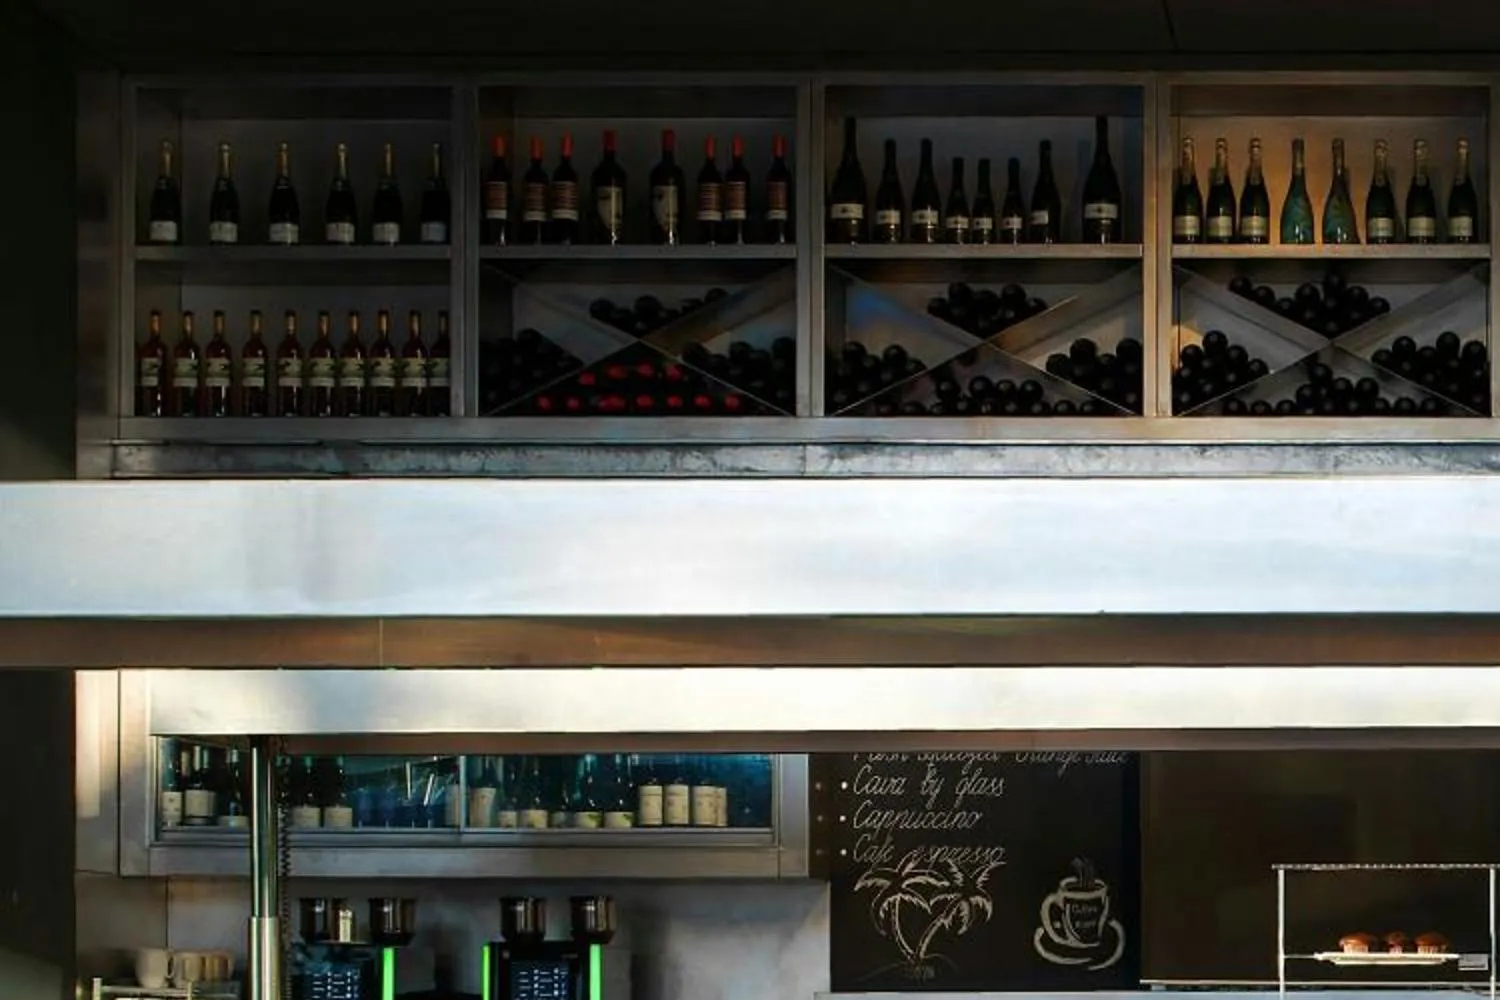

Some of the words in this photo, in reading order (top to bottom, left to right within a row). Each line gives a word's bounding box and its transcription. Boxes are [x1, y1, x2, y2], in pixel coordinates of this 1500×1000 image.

[853, 764, 907, 796] Cava
[920, 763, 946, 811] by
[955, 767, 1005, 809] glass
[853, 800, 984, 842] Cappuccino
